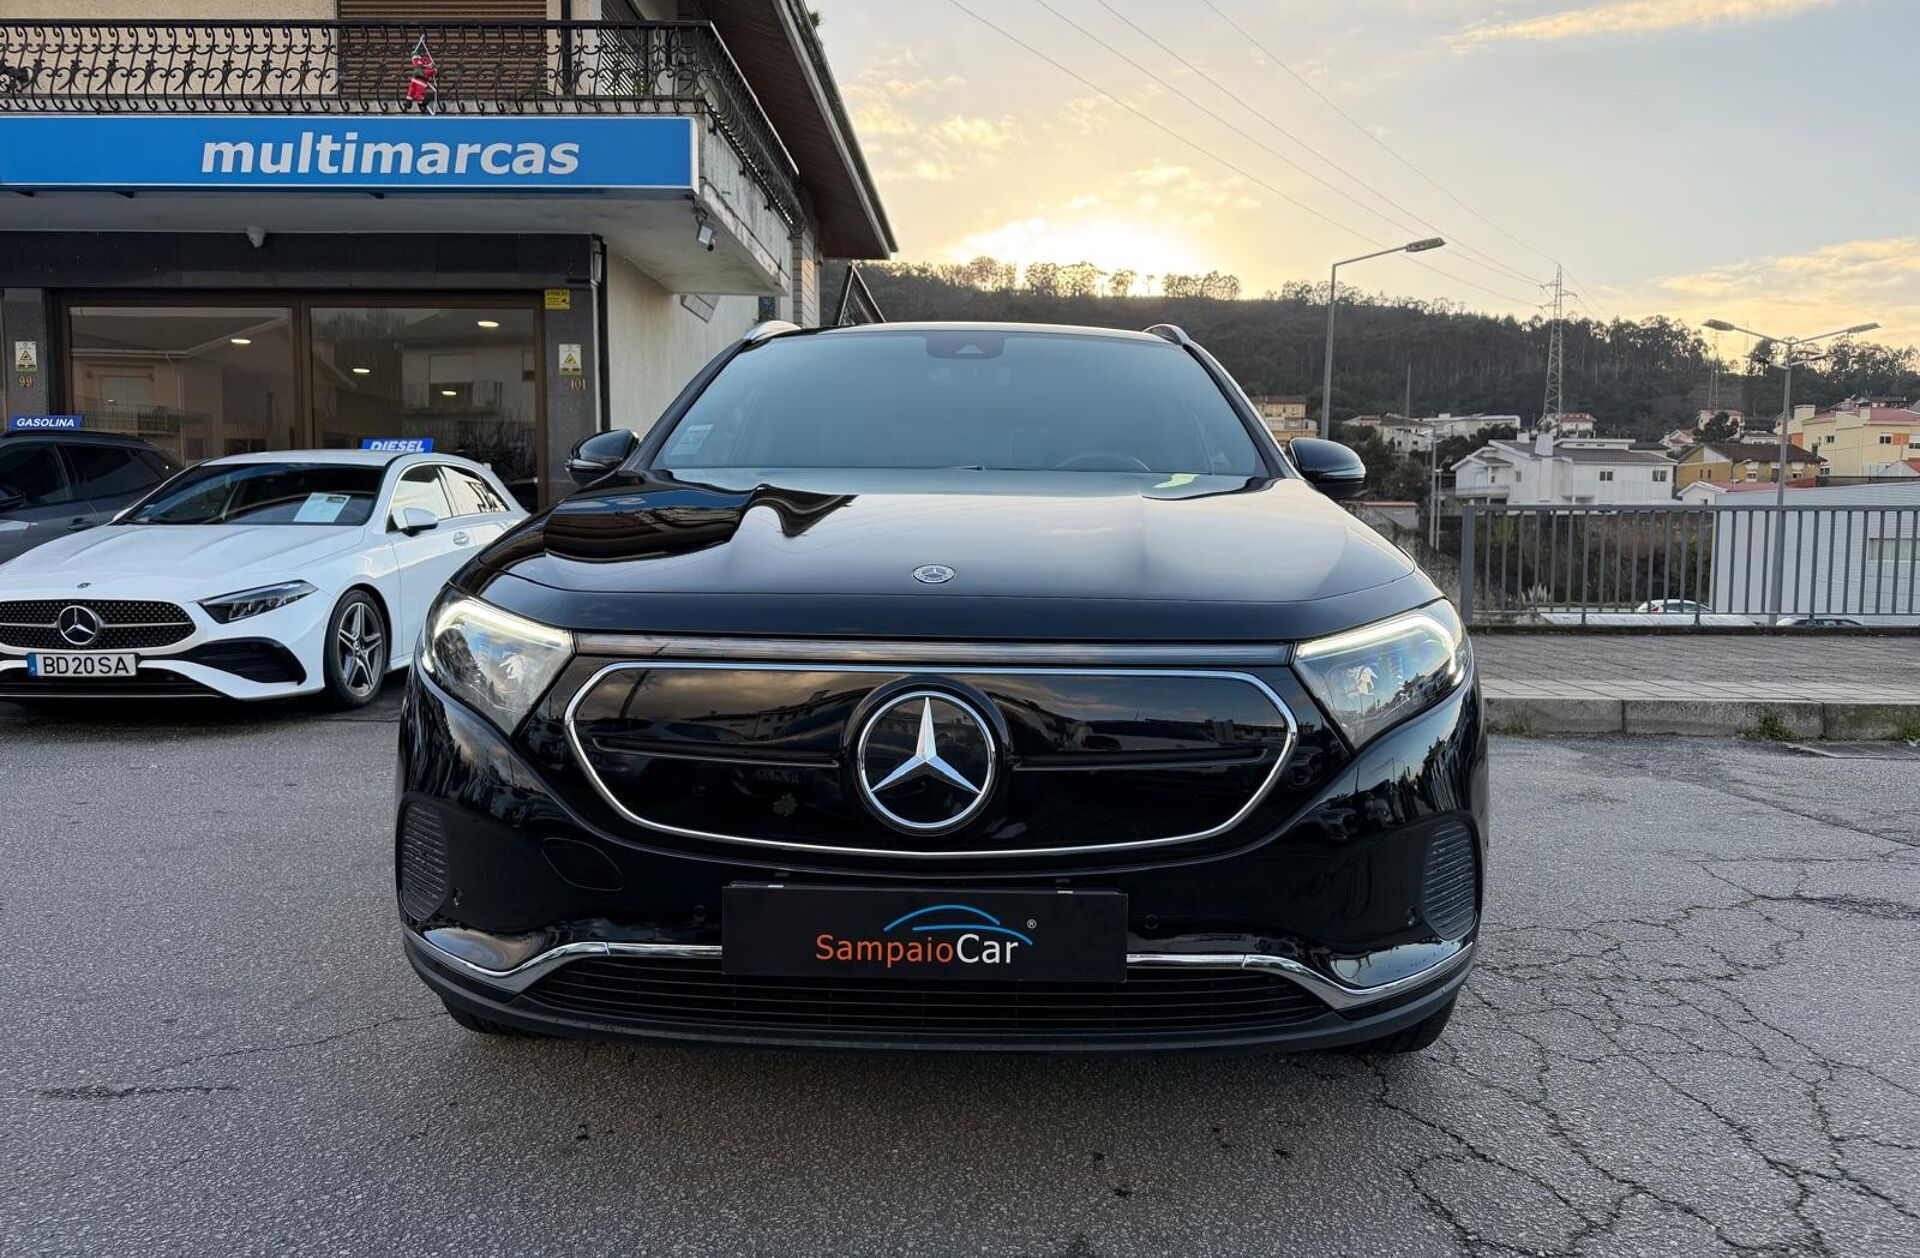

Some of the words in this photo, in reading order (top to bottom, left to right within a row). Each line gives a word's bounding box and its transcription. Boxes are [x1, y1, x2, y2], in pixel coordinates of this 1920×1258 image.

[201, 131, 580, 174] multimarcas
[16, 418, 75, 427] GASOLINA
[370, 440, 425, 452] DIESEL
[815, 933, 1019, 969] SampaioCar
